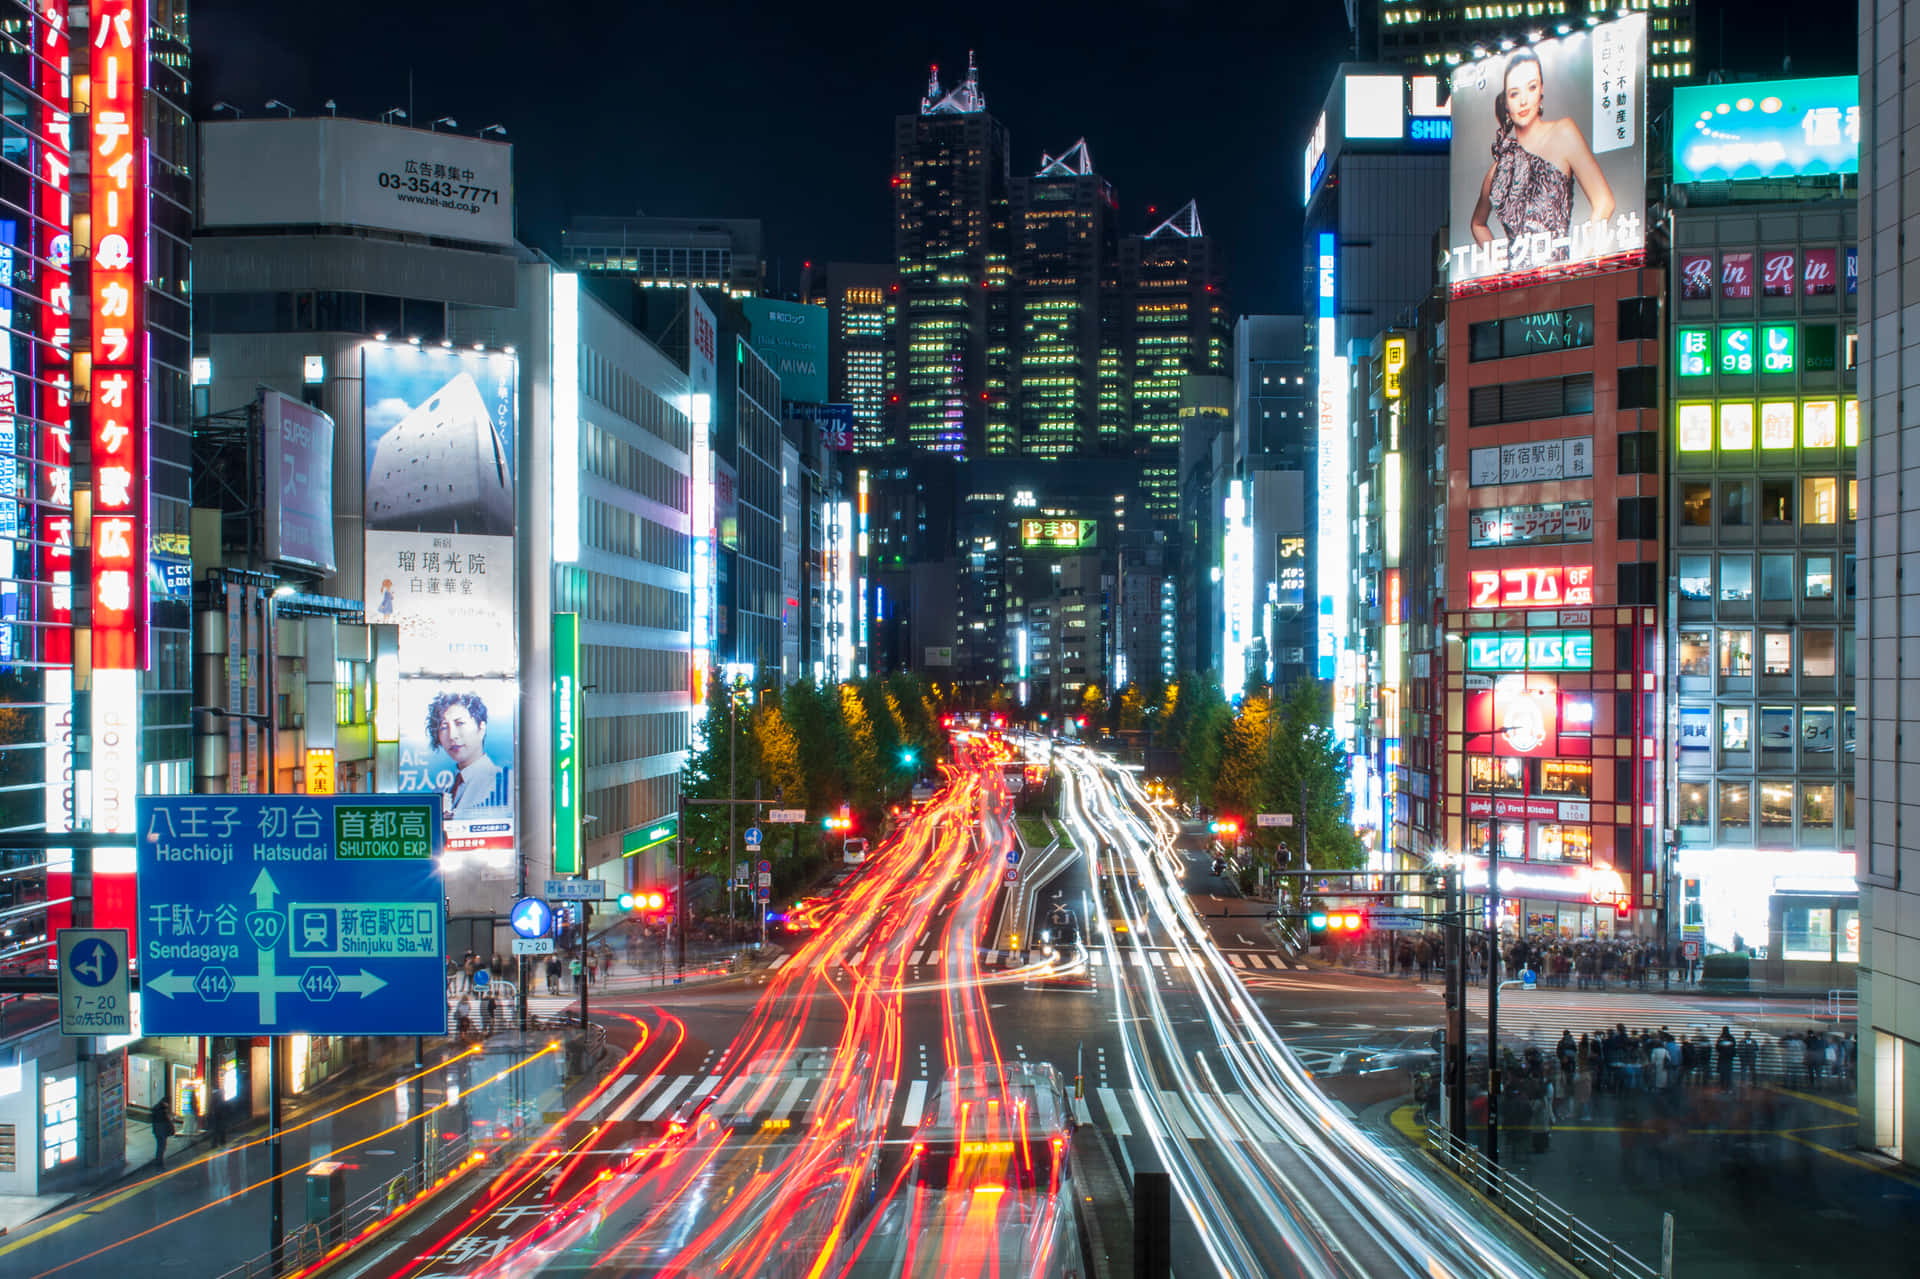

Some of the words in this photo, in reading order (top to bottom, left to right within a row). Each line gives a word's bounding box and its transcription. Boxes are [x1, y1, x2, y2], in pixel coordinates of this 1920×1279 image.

[405, 159, 475, 183] 広告募集中
[378, 172, 499, 205] 03-3543-7771
[398, 192, 480, 214] www.hit-ad.co.jp
[781, 359, 816, 377] MIWA
[1503, 445, 1561, 465] 新宿駅前
[1573, 440, 1585, 474] 歯科
[1027, 521, 1077, 538] やまや
[398, 551, 486, 575] 瑠璃光院
[1475, 567, 1558, 604] アコム
[149, 806, 242, 838] 八王子
[257, 805, 323, 838] 初台
[340, 810, 425, 839] 首都高
[156, 843, 234, 865] Hachioji
[253, 842, 328, 861] Hatsudai
[339, 840, 400, 857] SHUTOKO
[403, 840, 427, 856] EXP
[253, 918, 277, 937] 20
[340, 908, 433, 936] 新宿駅西口
[149, 941, 239, 962] Sendagaya
[341, 936, 394, 957] Shinjuku
[397, 937, 435, 953] Sta.-W.
[518, 942, 547, 951] 7-20
[201, 975, 228, 992] 414
[306, 975, 333, 992] 414
[75, 996, 116, 1010] 7-20
[66, 1011, 125, 1027] この先50m
